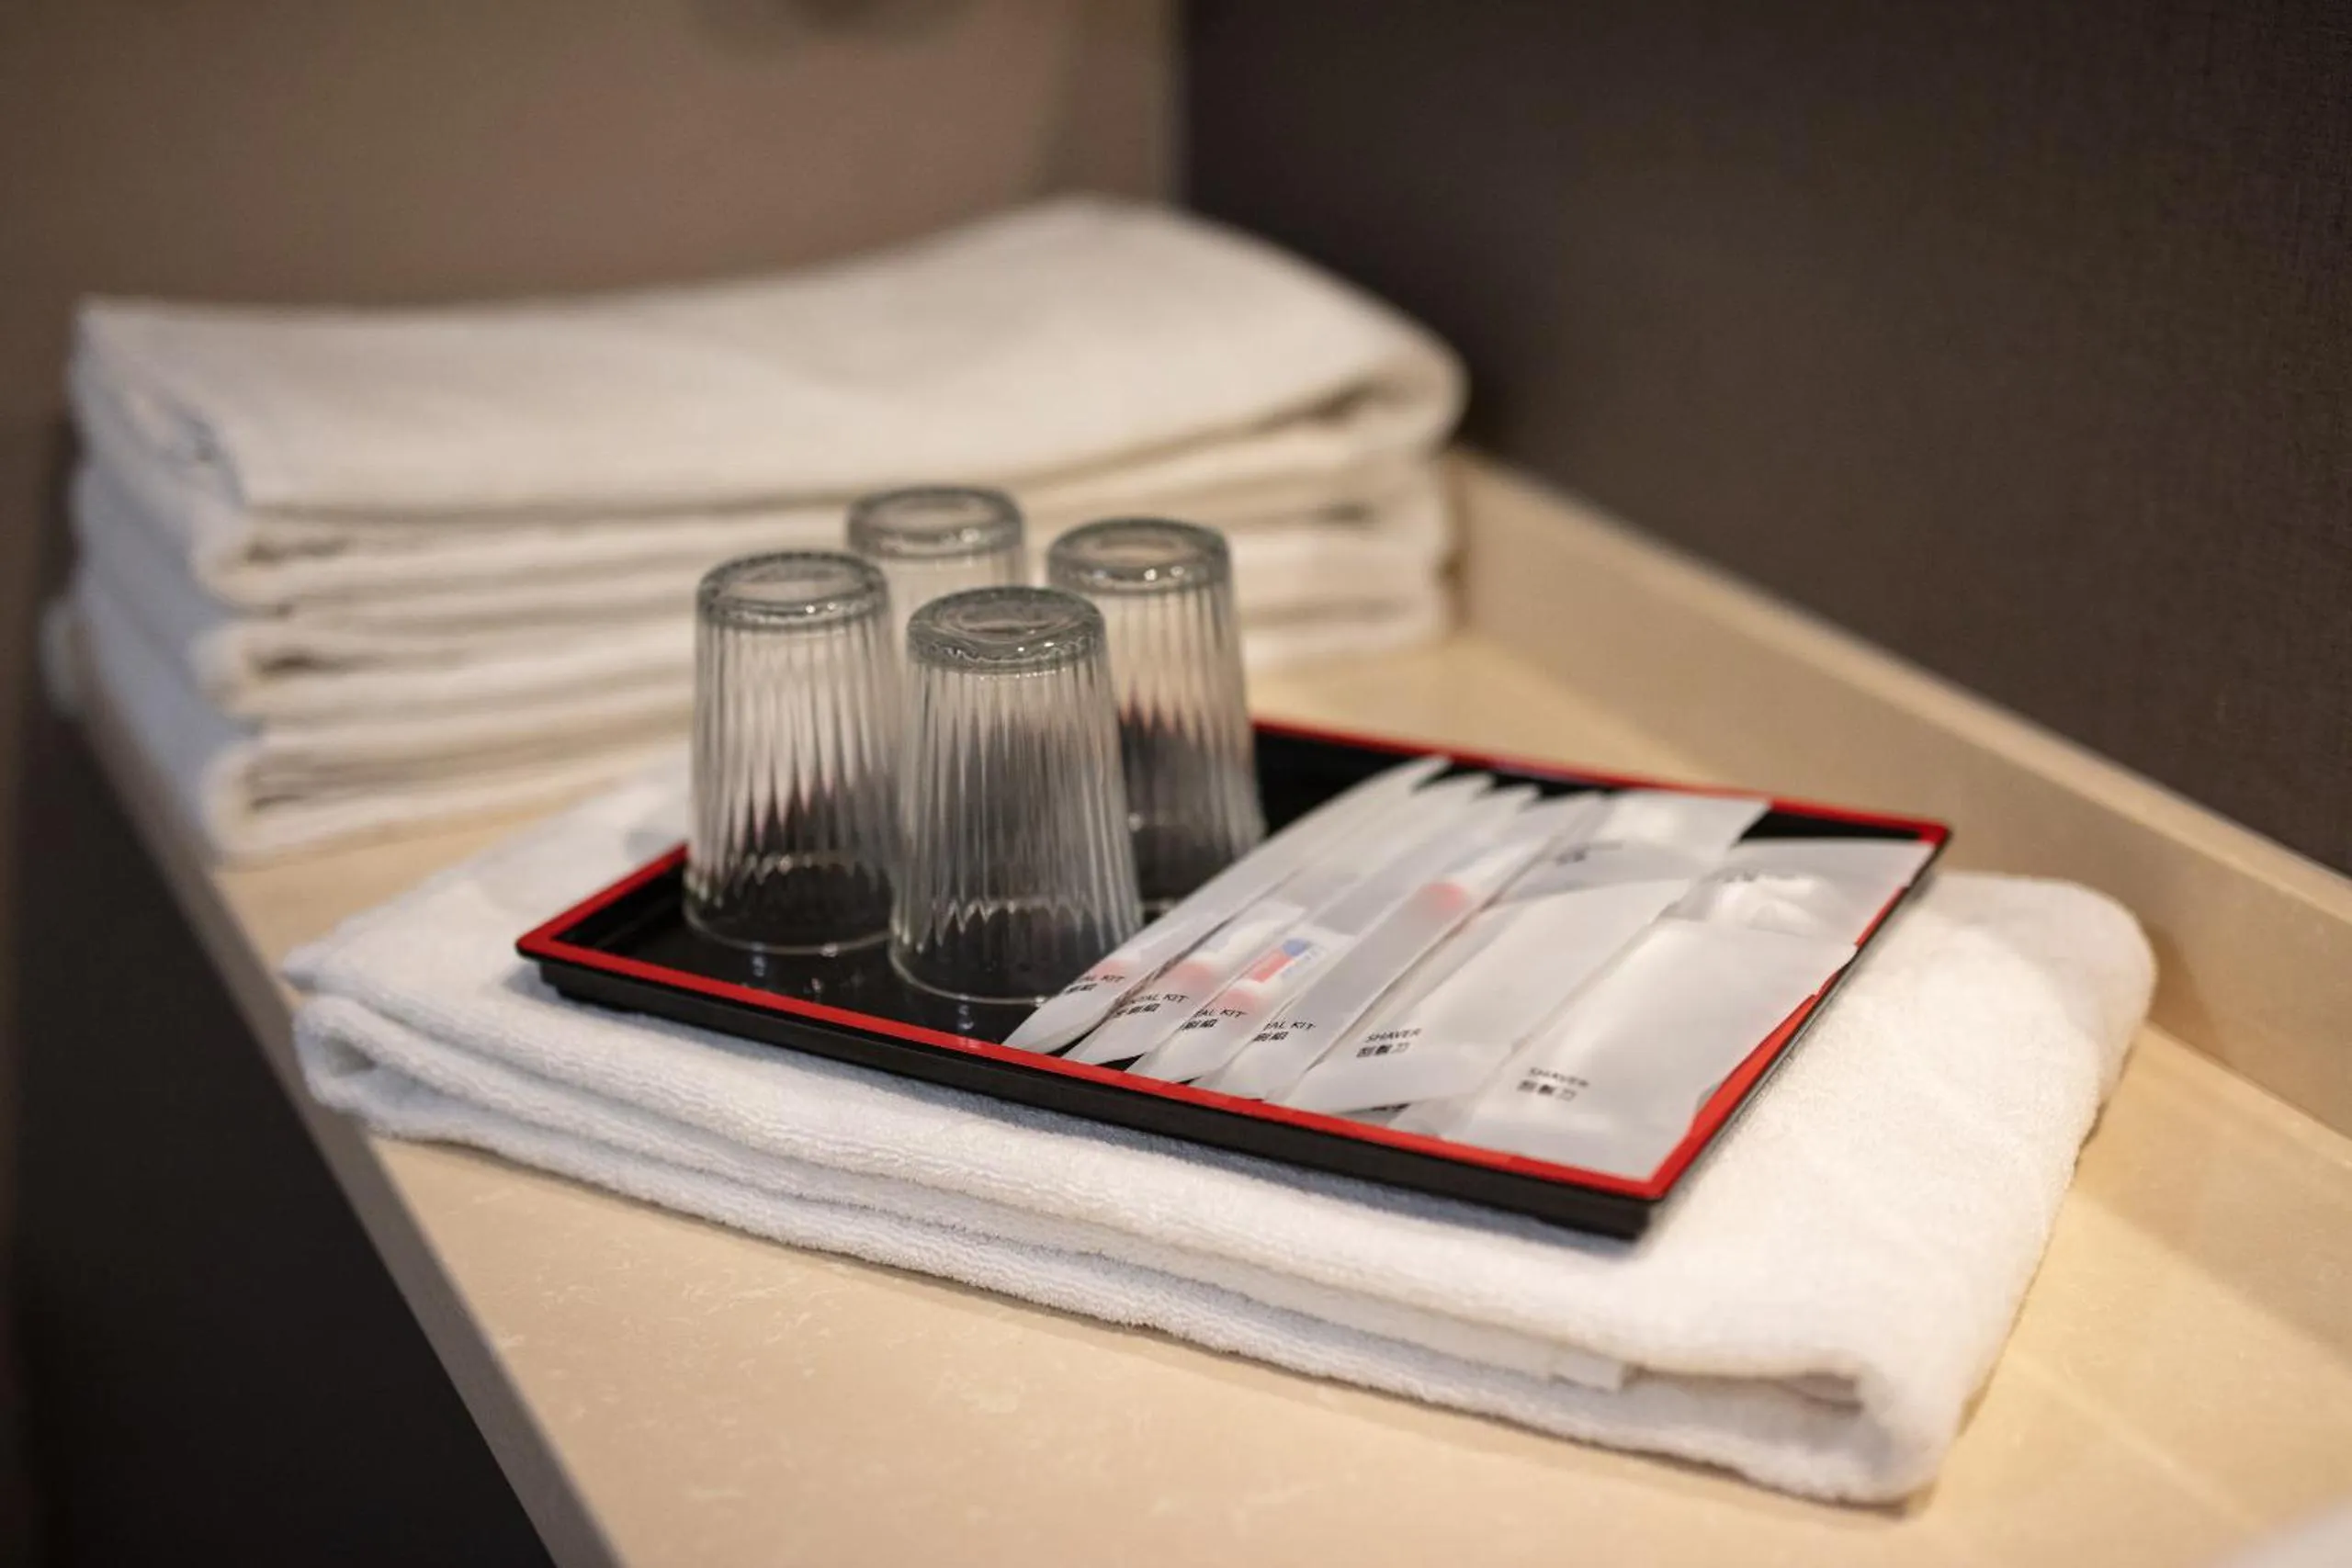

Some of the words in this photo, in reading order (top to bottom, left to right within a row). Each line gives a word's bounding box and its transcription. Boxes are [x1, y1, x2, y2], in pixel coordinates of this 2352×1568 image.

[1102, 975, 1125, 983] KIT
[1163, 993, 1189, 1003] KIT
[1219, 1009, 1247, 1018] KIT
[1291, 1021, 1316, 1030] KIT
[1365, 1028, 1422, 1043] SHAVER
[1528, 1066, 1591, 1088] SHAVER
